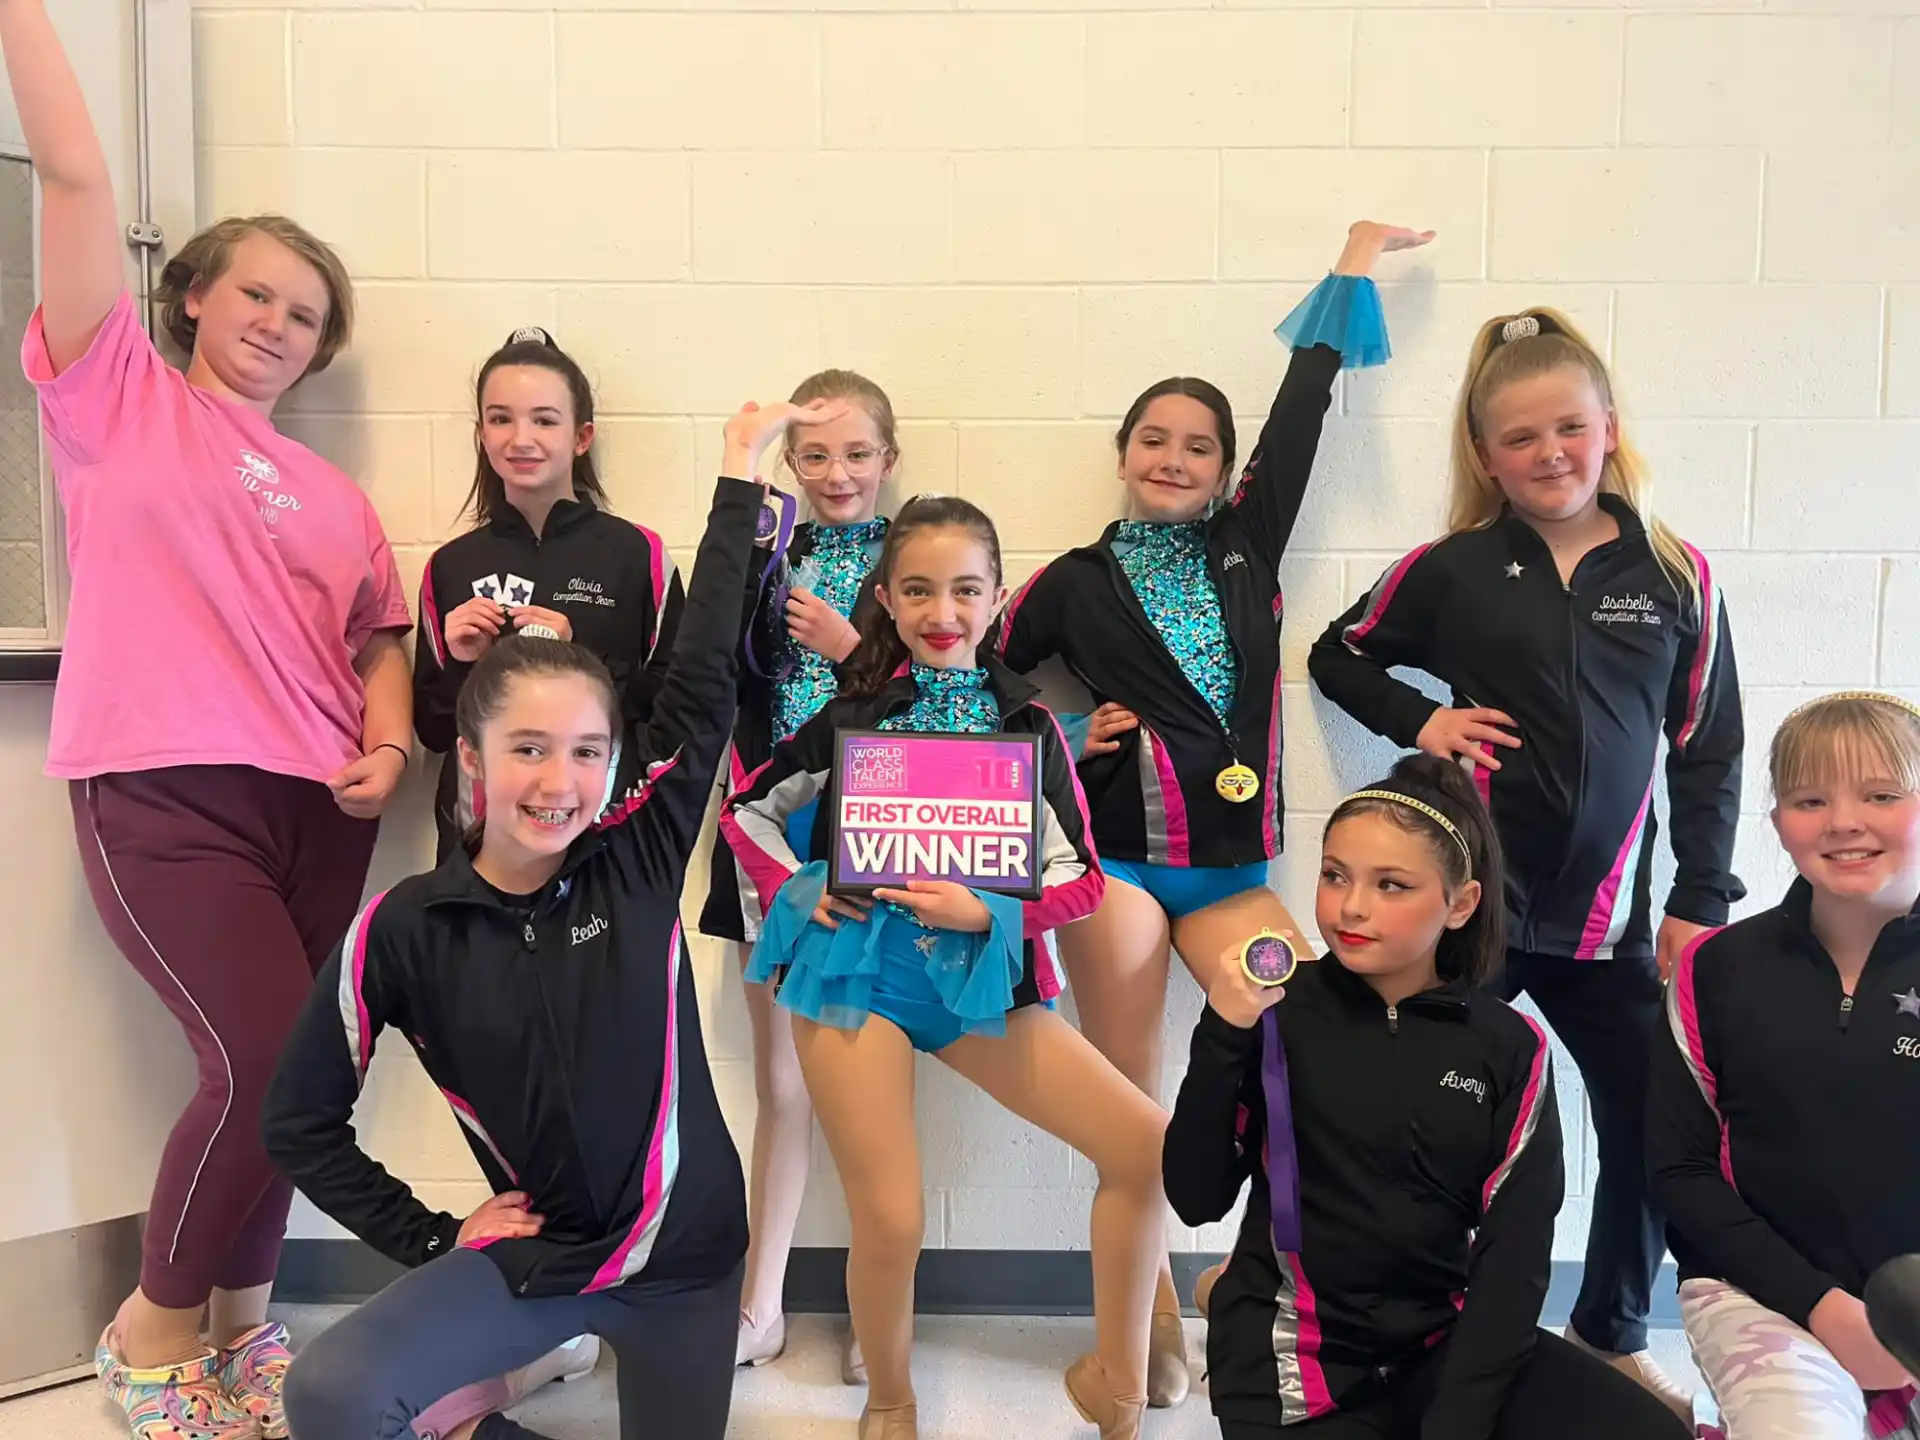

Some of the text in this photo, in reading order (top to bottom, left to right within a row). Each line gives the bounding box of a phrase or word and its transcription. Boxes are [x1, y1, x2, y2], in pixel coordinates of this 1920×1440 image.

[567, 576, 604, 593] Olivia
[552, 592, 616, 608] Competition Team
[1599, 592, 1655, 611] Isabelle
[1591, 610, 1662, 626] Competition Team
[851, 747, 903, 759] WORLD
[852, 757, 904, 771] CLASS
[852, 769, 904, 781] TALENT
[845, 802, 1028, 827] FIRST OVERALL
[844, 831, 1029, 878] WINNER
[571, 913, 608, 946] Leah
[1439, 1070, 1486, 1104] Avery
